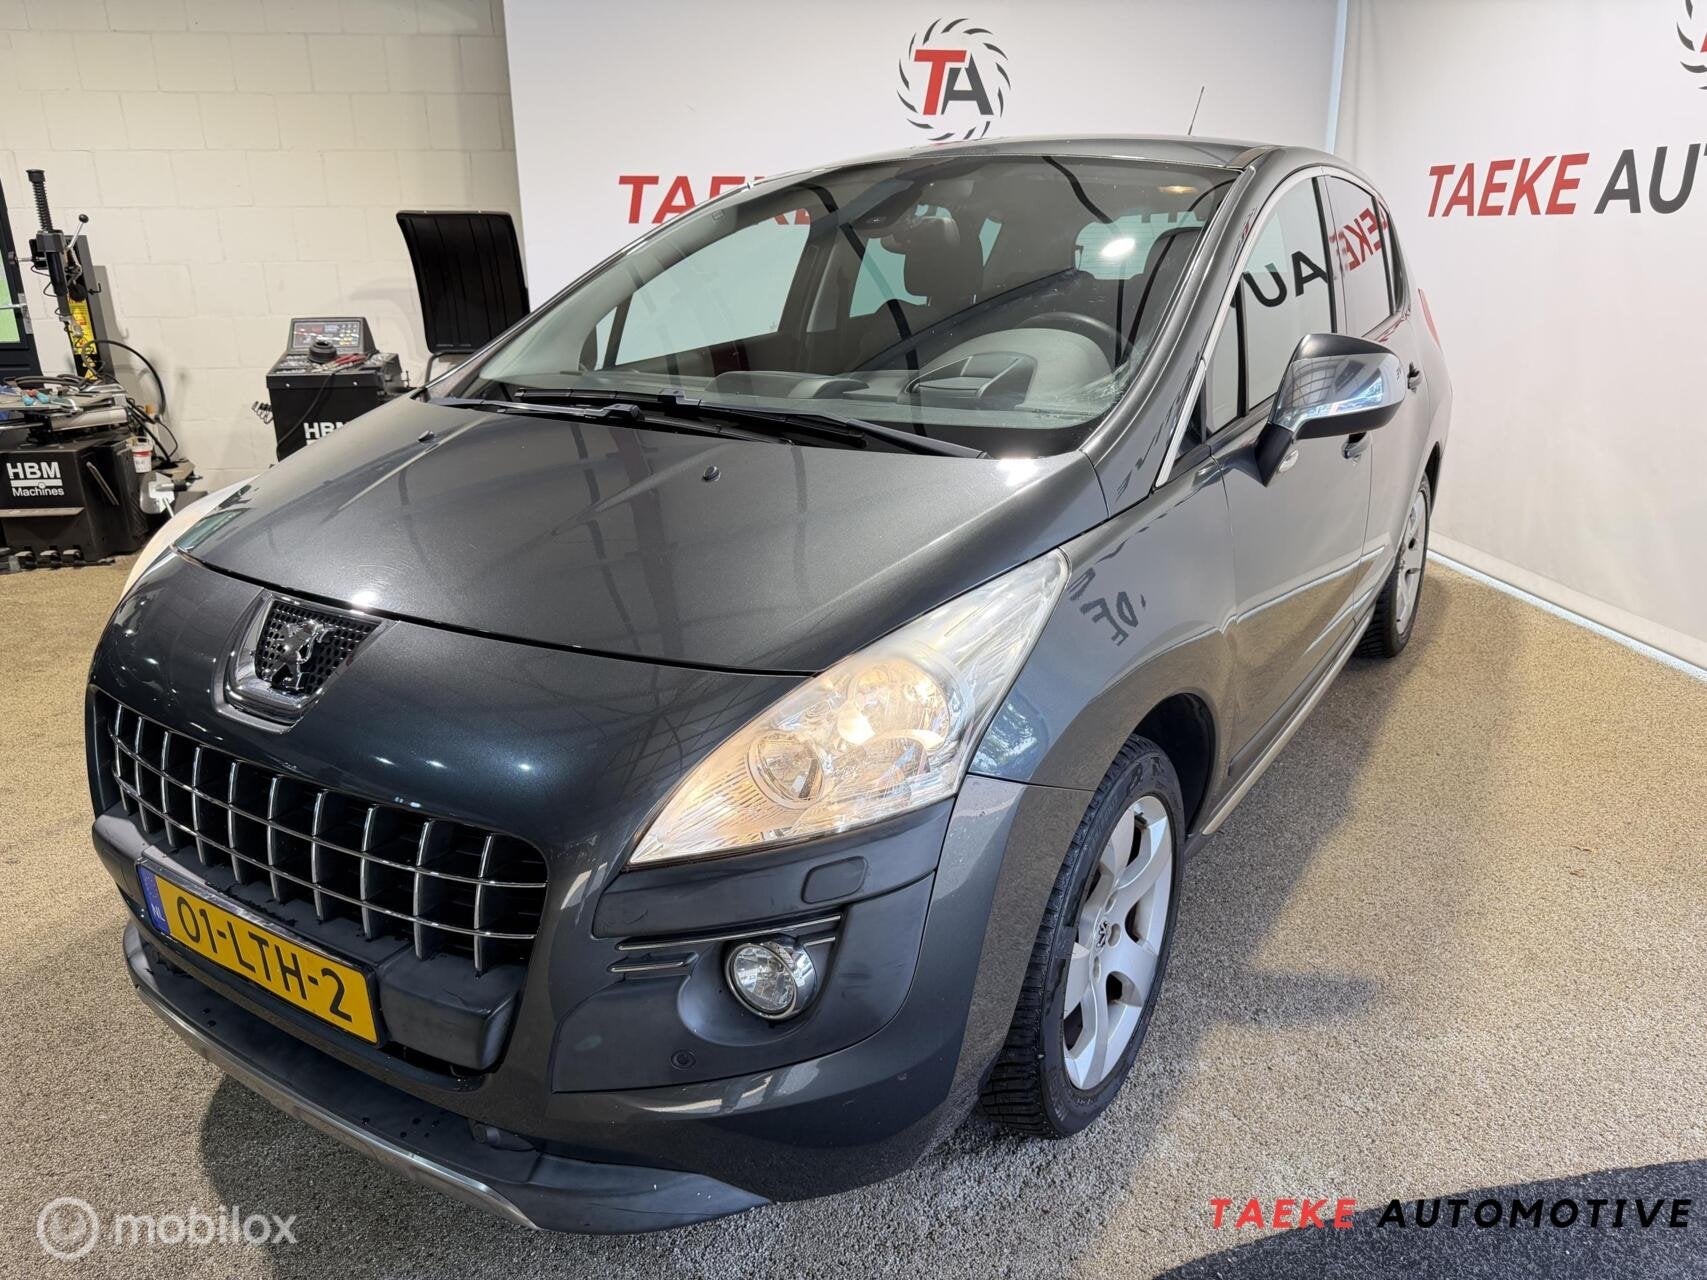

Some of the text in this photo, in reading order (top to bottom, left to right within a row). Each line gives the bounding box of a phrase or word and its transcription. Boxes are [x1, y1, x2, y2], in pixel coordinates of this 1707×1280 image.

[914, 49, 994, 115] TA
[1427, 143, 1707, 217] TAEKE AU
[303, 421, 345, 438] HB
[6, 461, 61, 479] HBM
[12, 487, 65, 497] Machines
[151, 903, 166, 922] NL
[176, 896, 353, 1023] 01-LTH-2
